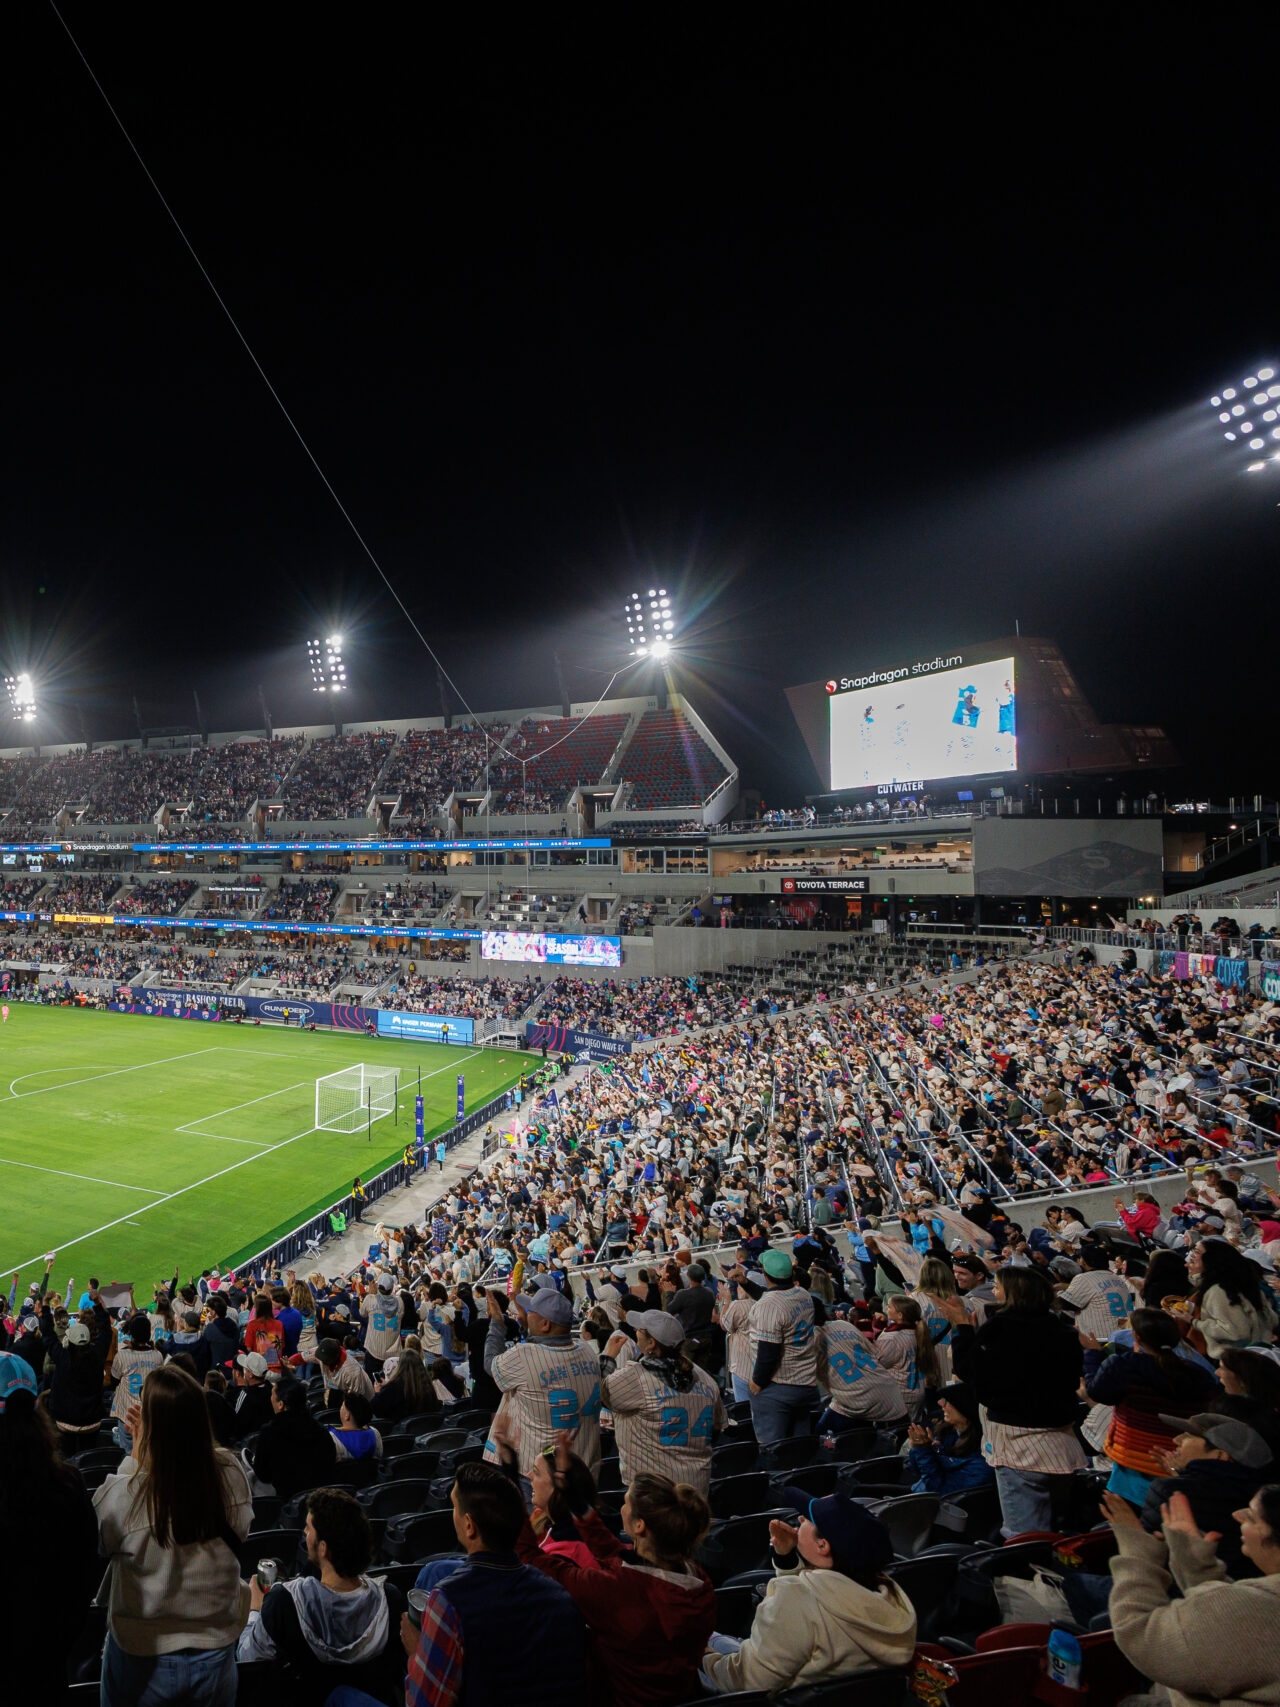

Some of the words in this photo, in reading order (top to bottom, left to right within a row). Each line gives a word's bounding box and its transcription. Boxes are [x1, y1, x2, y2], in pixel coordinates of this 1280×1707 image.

[840, 667, 909, 689] Snapdragon
[911, 655, 963, 674] stadium
[877, 781, 924, 795] CUTWATER
[73, 843, 105, 852] Snapdragon
[106, 843, 129, 851] stadium
[795, 881, 826, 889] TOYOTA
[827, 881, 865, 889] TERRACE
[1217, 958, 1247, 988] COVE
[574, 1035, 585, 1045] SAN
[585, 1037, 601, 1049] DIEGO
[601, 1041, 617, 1052] WAVE
[617, 1044, 625, 1053] FC
[374, 1313, 399, 1332] 24
[828, 1344, 876, 1384] 24
[540, 1368, 568, 1388] SAN
[548, 1383, 600, 1429] 24
[660, 1405, 713, 1447] 24
